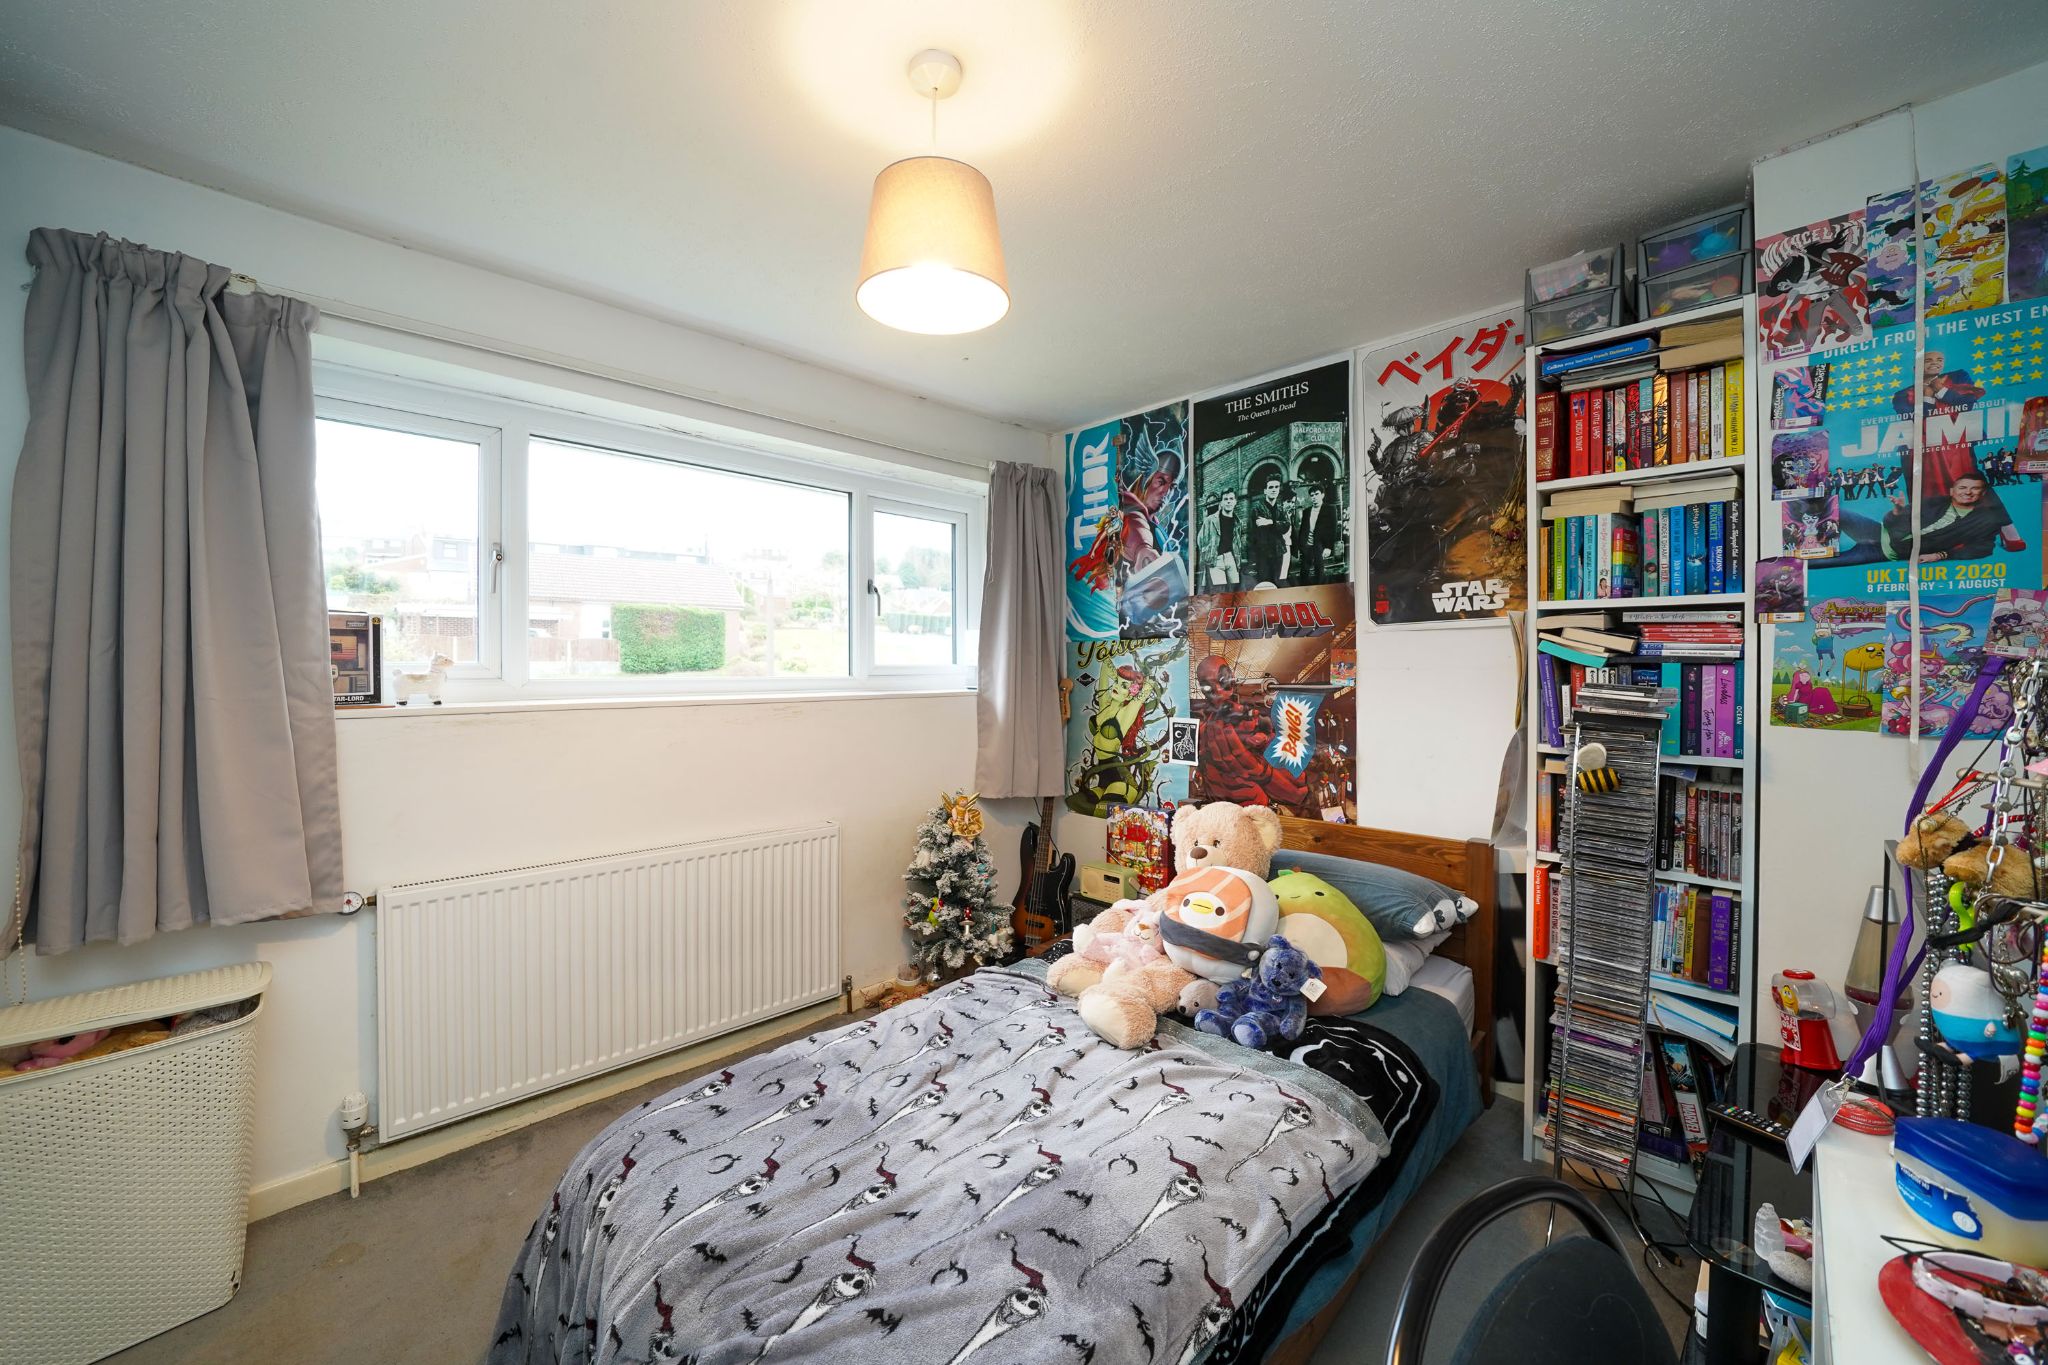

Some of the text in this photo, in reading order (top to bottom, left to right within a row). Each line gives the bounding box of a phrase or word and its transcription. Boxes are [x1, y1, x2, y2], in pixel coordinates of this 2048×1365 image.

[1824, 341, 1879, 359] DIRECT
[1936, 319, 1968, 336] THE
[1974, 309, 2023, 329] WEST
[1225, 381, 1310, 414] THE SMITHS
[1237, 401, 1297, 423] The Queen Is Dead
[1861, 398, 2006, 426] EVERYBODY TALKING ABOUT
[1955, 442, 1972, 450] FOR
[1073, 431, 1110, 551] THOR
[1709, 504, 1718, 540] PRATCHETT
[1730, 530, 1740, 549] Telegraph
[1715, 545, 1723, 572] DRAGONS
[1867, 563, 2007, 584] UK TUR 2020
[1867, 584, 1874, 593] 8
[1877, 581, 1936, 592] FEBRRY
[1958, 579, 2006, 589] AUGUST
[1432, 579, 1511, 599] STAR
[1432, 593, 1510, 613] WARS
[1204, 601, 1335, 640] DEADPOOL
[1720, 678, 1732, 705] Loveless
[1281, 703, 1303, 758] BANG!
[1685, 931, 1693, 954] Outsiders
[1681, 1103, 1701, 1134] MARVEL
